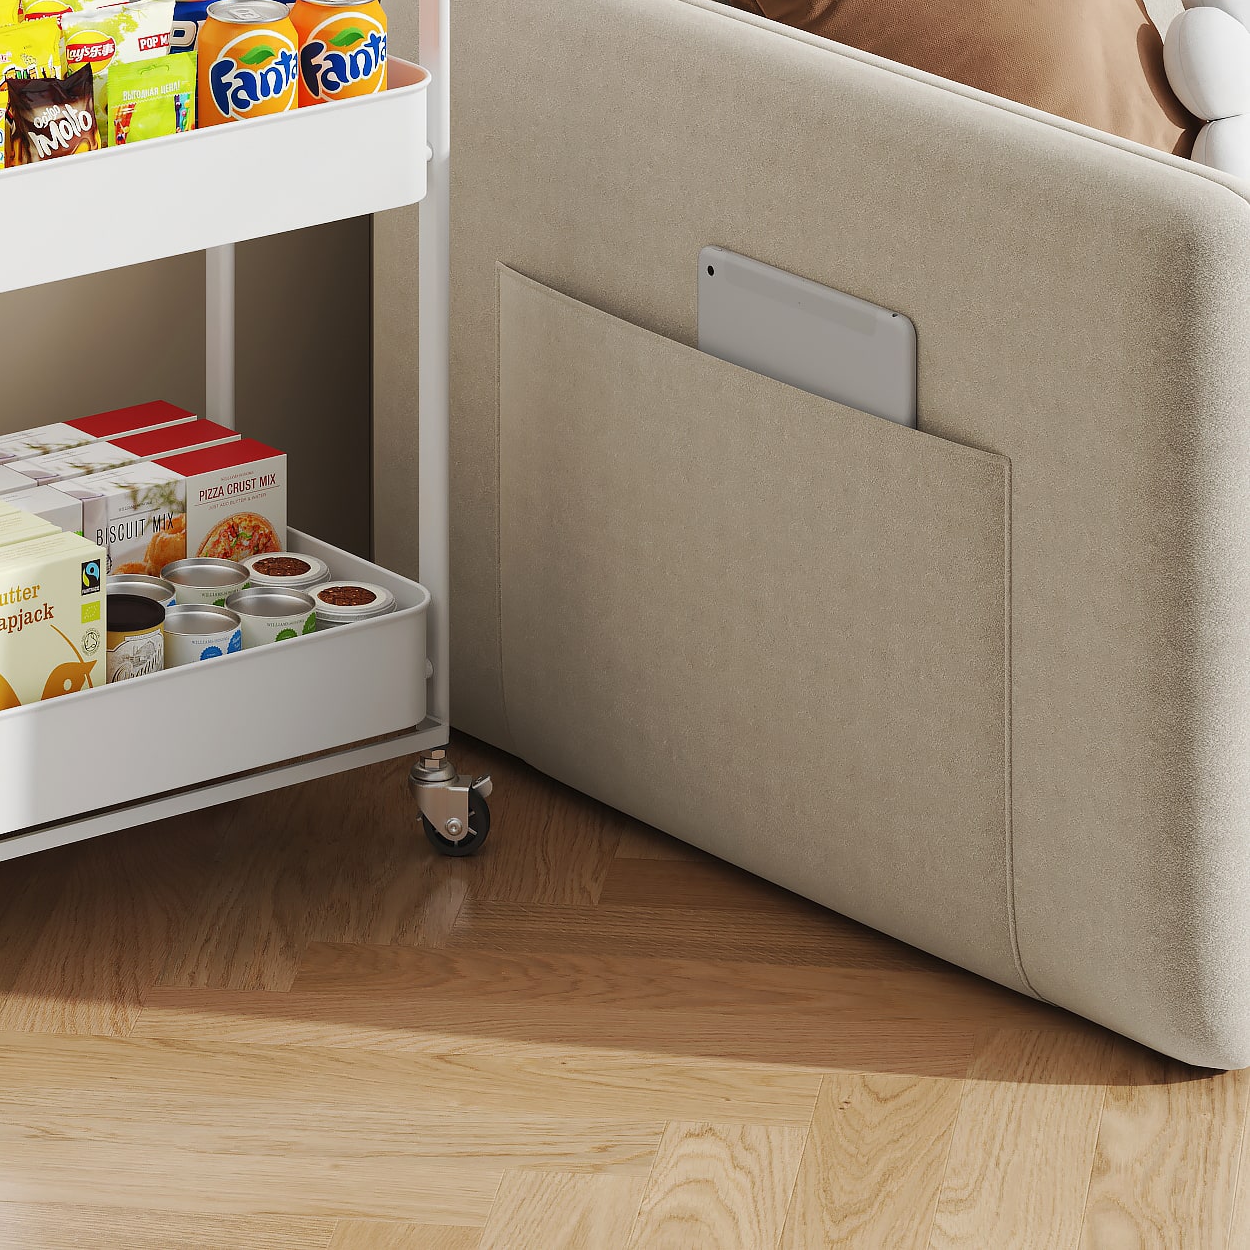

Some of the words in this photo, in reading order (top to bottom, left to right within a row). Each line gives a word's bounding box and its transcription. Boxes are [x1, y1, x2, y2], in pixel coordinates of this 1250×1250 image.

[140, 36, 158, 50] POP
[122, 86, 159, 101] ВЫГОДНАЯ
[199, 485, 224, 502] PIZZA
[227, 477, 257, 495] CRUST
[259, 473, 276, 488] MIX
[96, 518, 146, 547] BISCUIT
[152, 512, 174, 533] MIX
